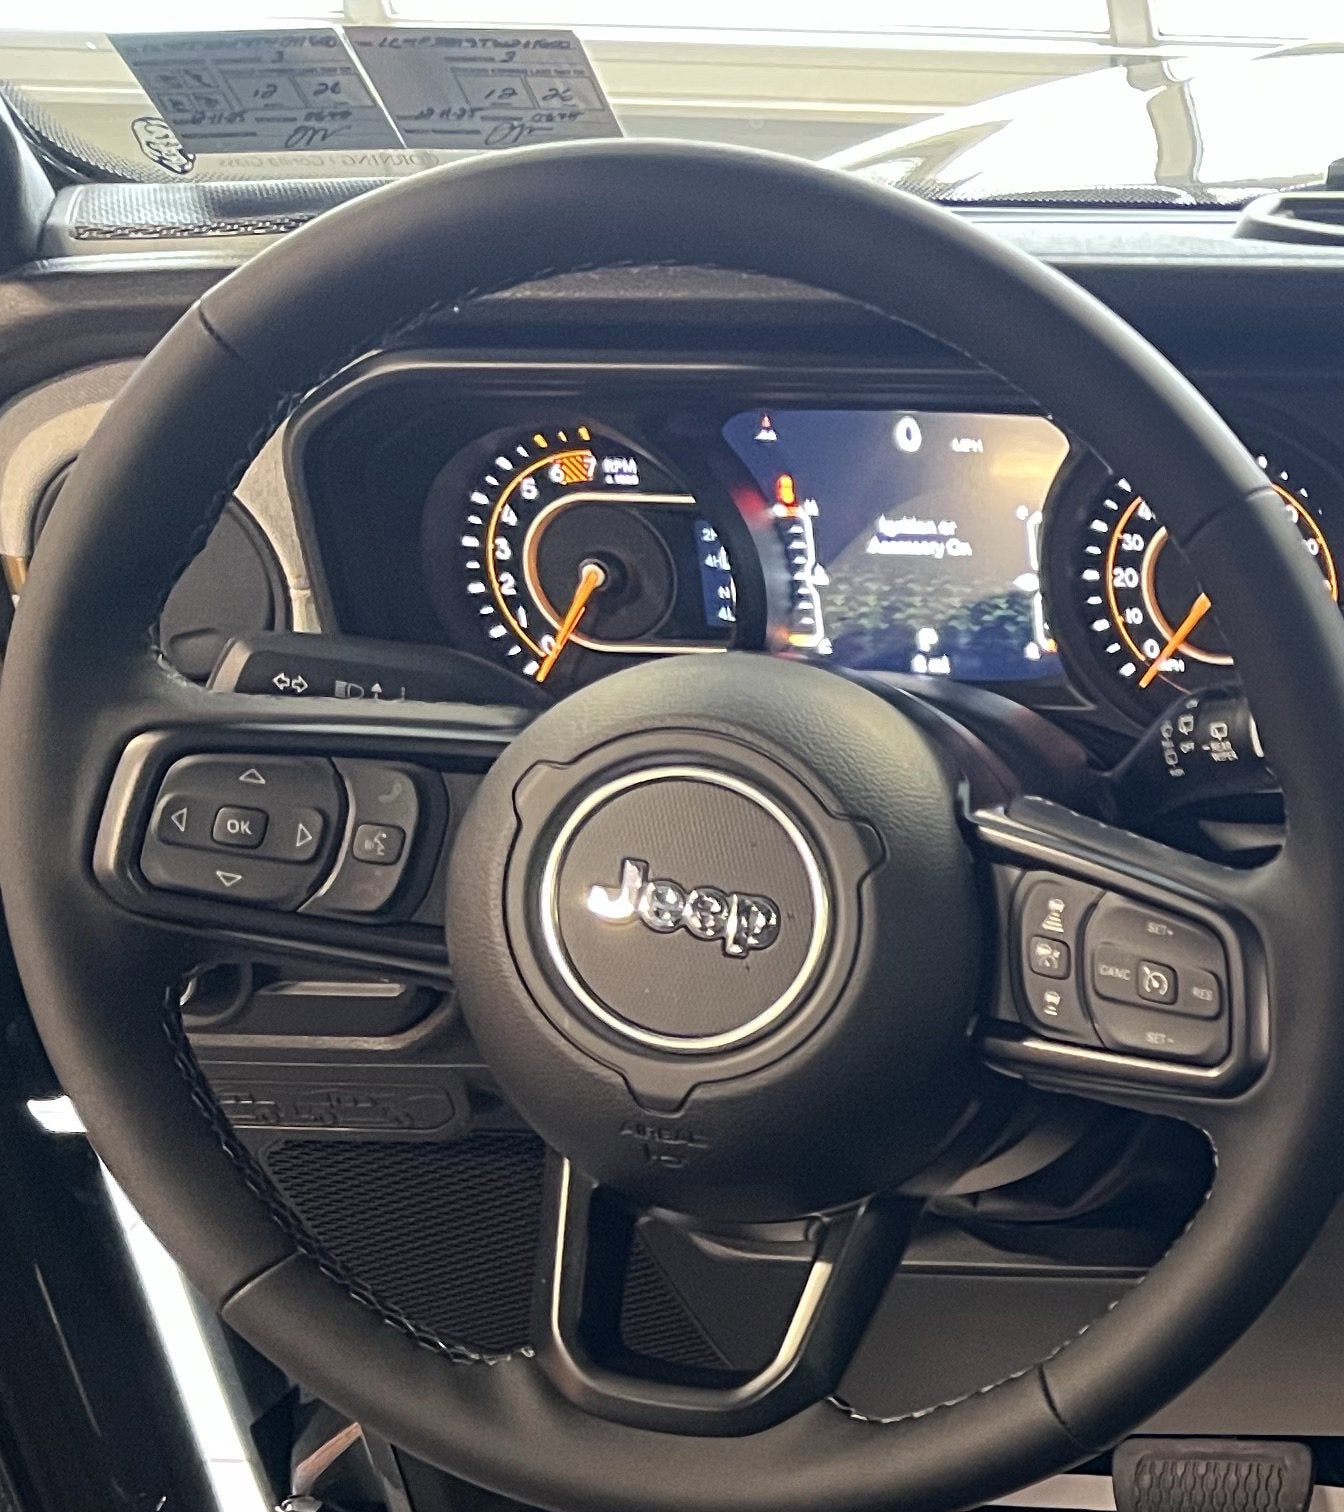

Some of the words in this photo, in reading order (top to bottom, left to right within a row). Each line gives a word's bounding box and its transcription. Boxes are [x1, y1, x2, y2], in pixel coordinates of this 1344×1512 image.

[895, 416, 922, 453] 0
[520, 477, 539, 500] 5
[501, 503, 518, 526] 4
[495, 537, 511, 561] 3
[1122, 533, 1145, 551] 30
[500, 572, 516, 596] 2
[1113, 567, 1139, 588] 20
[1125, 607, 1143, 624] 10
[1143, 638, 1160, 659] 0
[226, 818, 253, 836] OK
[586, 857, 781, 958] Jeep
[1100, 965, 1131, 981] CANC
